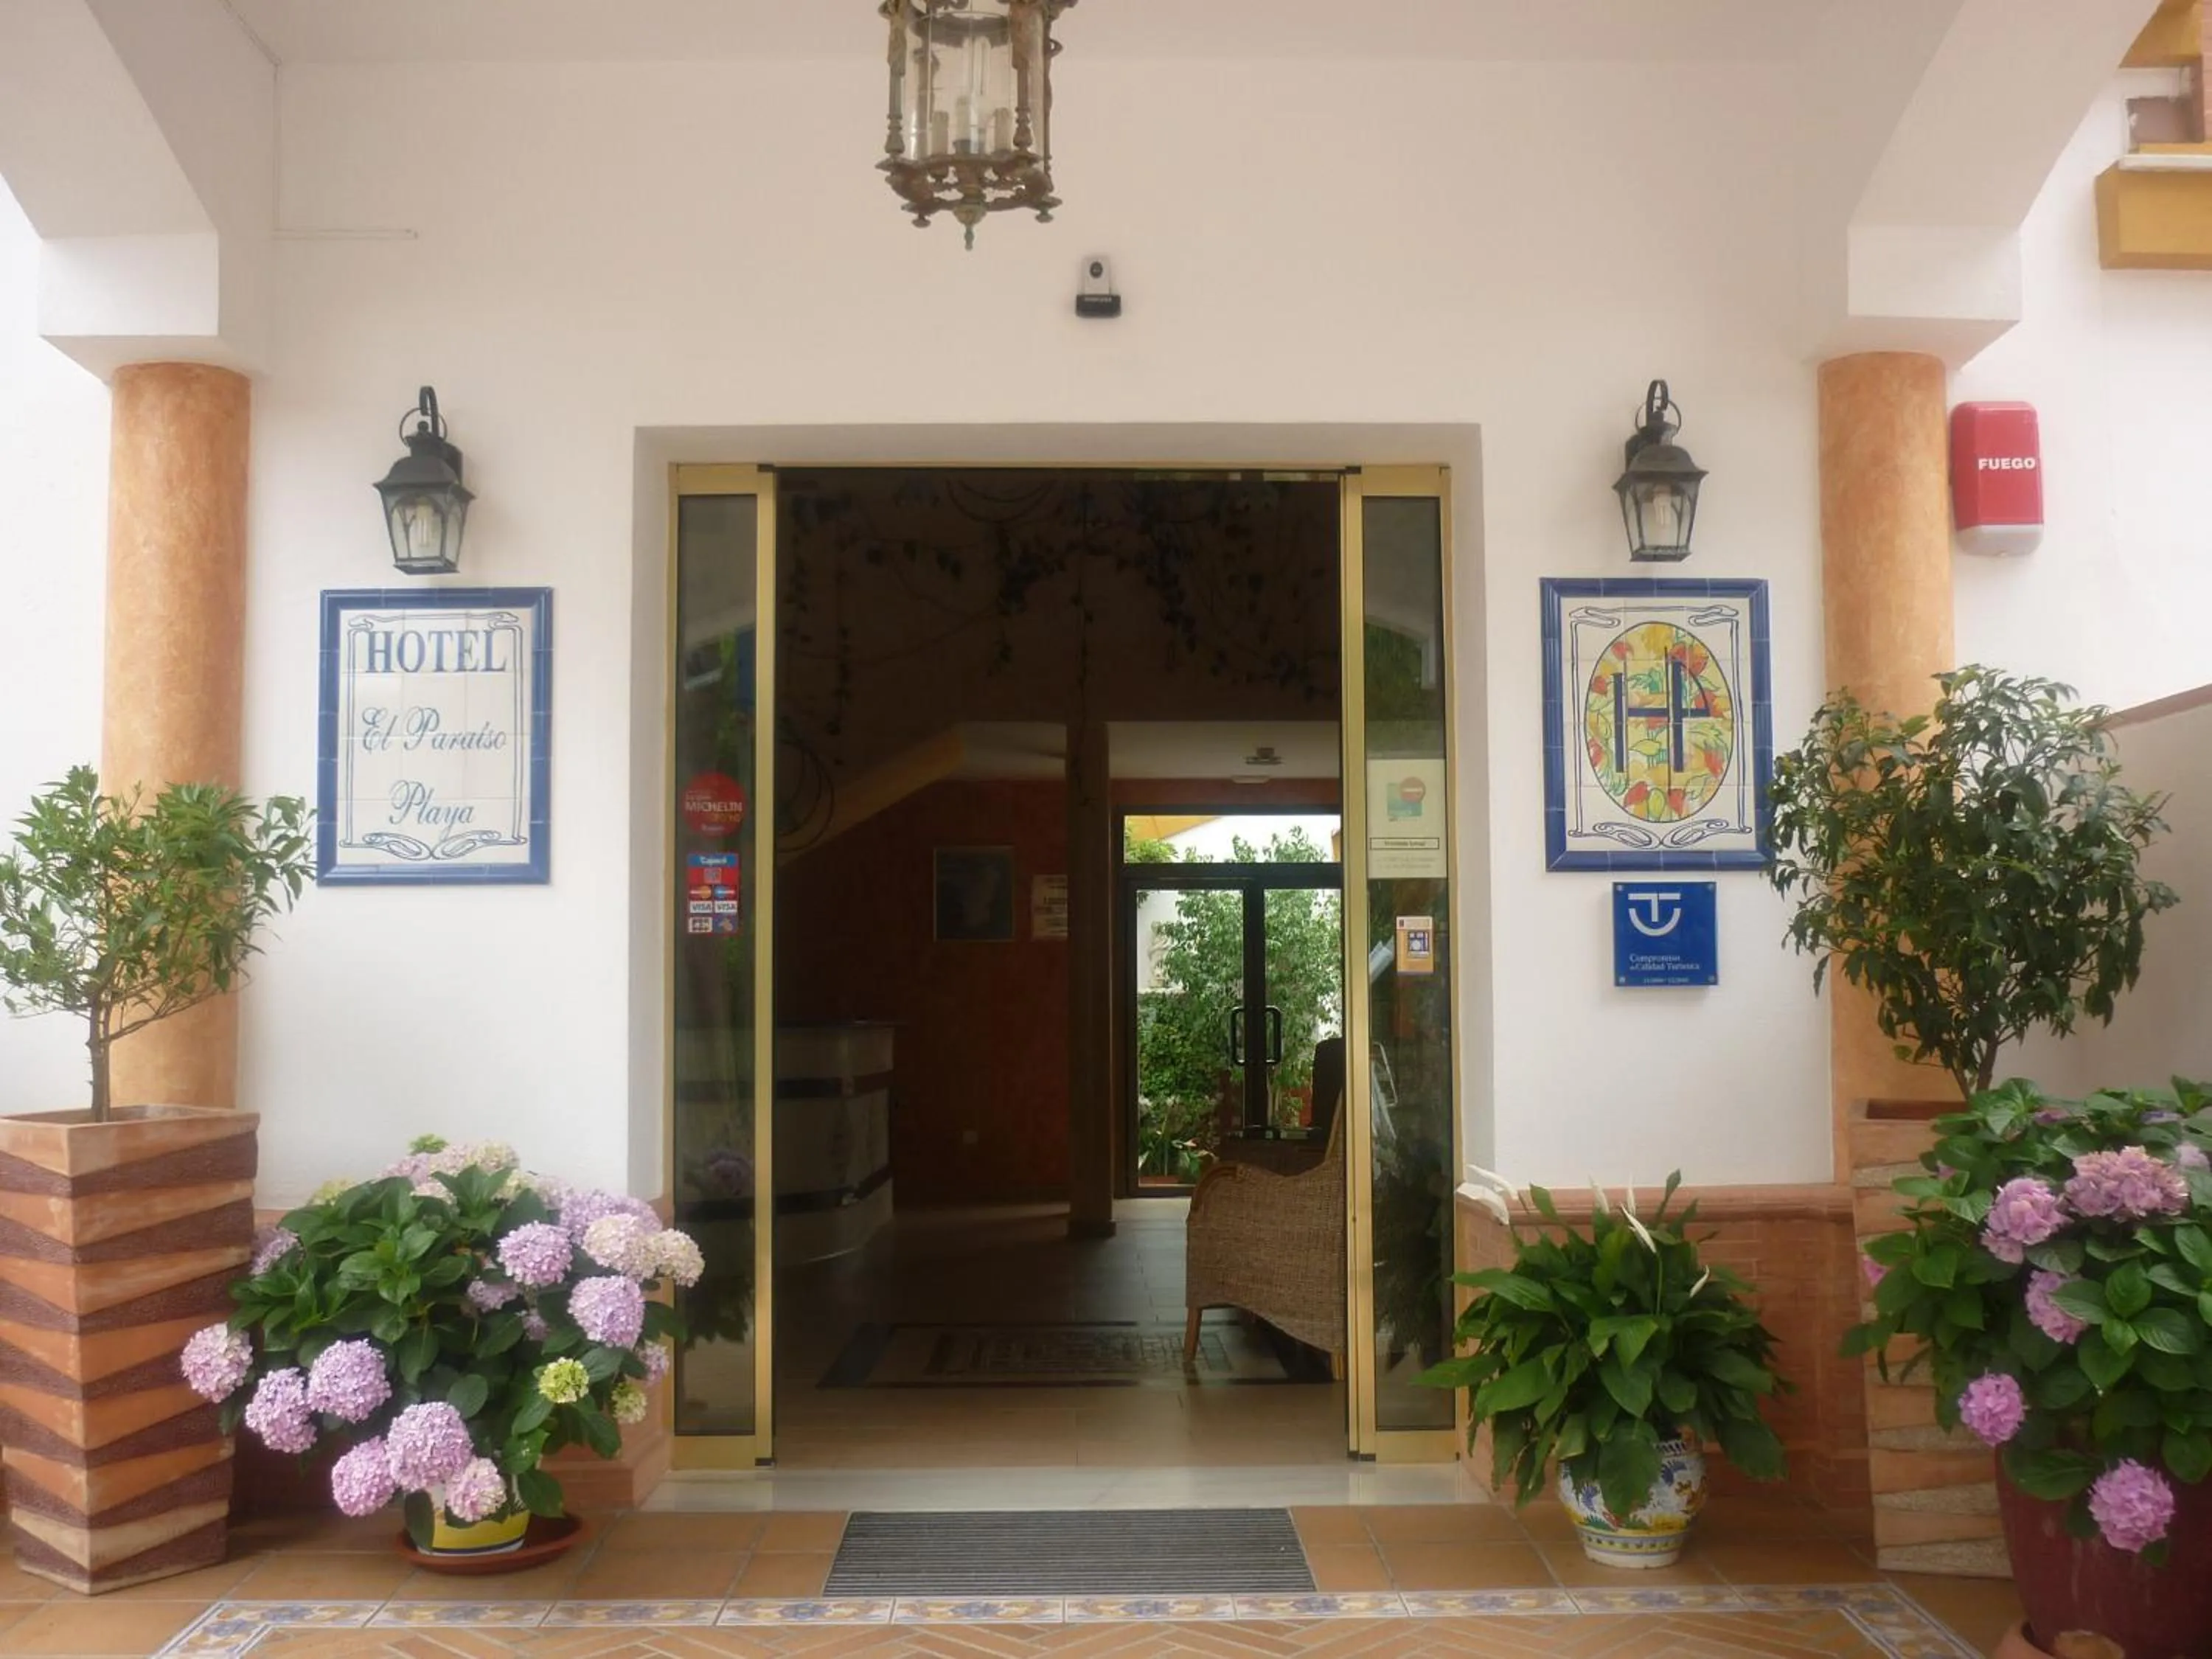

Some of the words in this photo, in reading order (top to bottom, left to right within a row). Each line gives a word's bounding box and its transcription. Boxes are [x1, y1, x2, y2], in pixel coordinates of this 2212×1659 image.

[1978, 457, 2036, 470] FUEGO
[366, 630, 508, 673] HOTEL
[361, 707, 399, 751] El
[389, 779, 476, 840] Playa
[684, 801, 743, 813] MICHELIN
